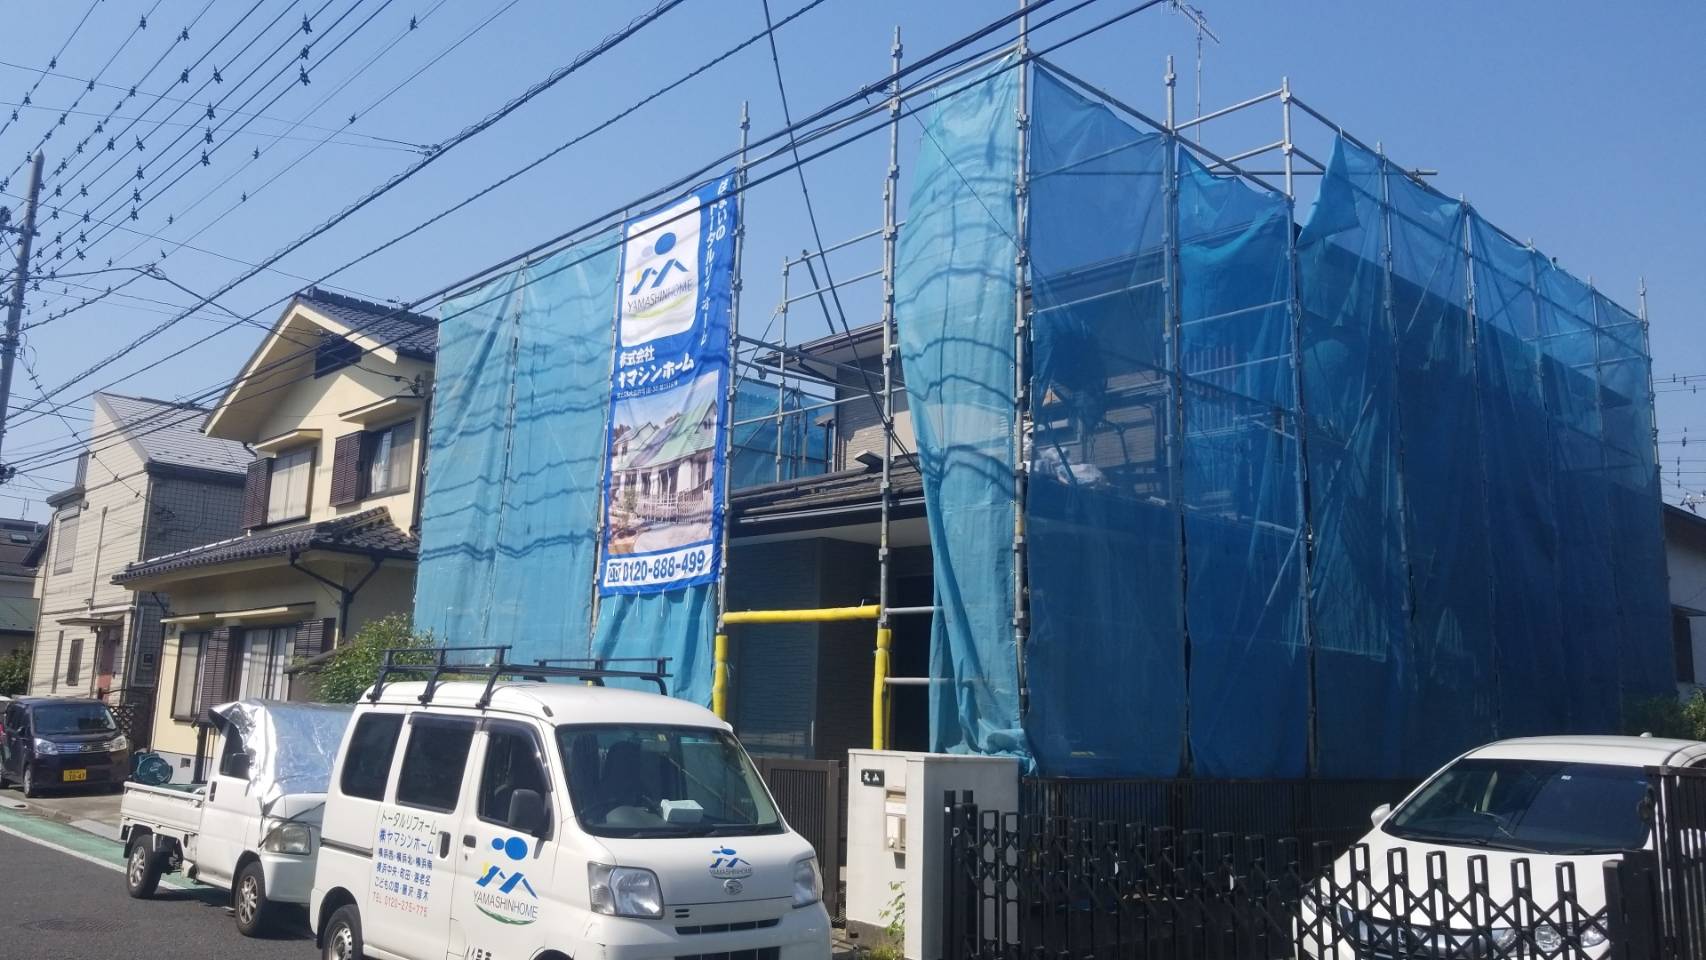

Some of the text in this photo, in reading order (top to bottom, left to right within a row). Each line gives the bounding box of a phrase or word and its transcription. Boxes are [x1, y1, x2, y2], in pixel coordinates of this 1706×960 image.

[627, 279, 693, 312] YAMASHINHOME
[623, 549, 705, 582] 0120-888-499
[380, 809, 437, 835] トータルリフォーム
[473, 890, 538, 919] YAMASHINHOME
